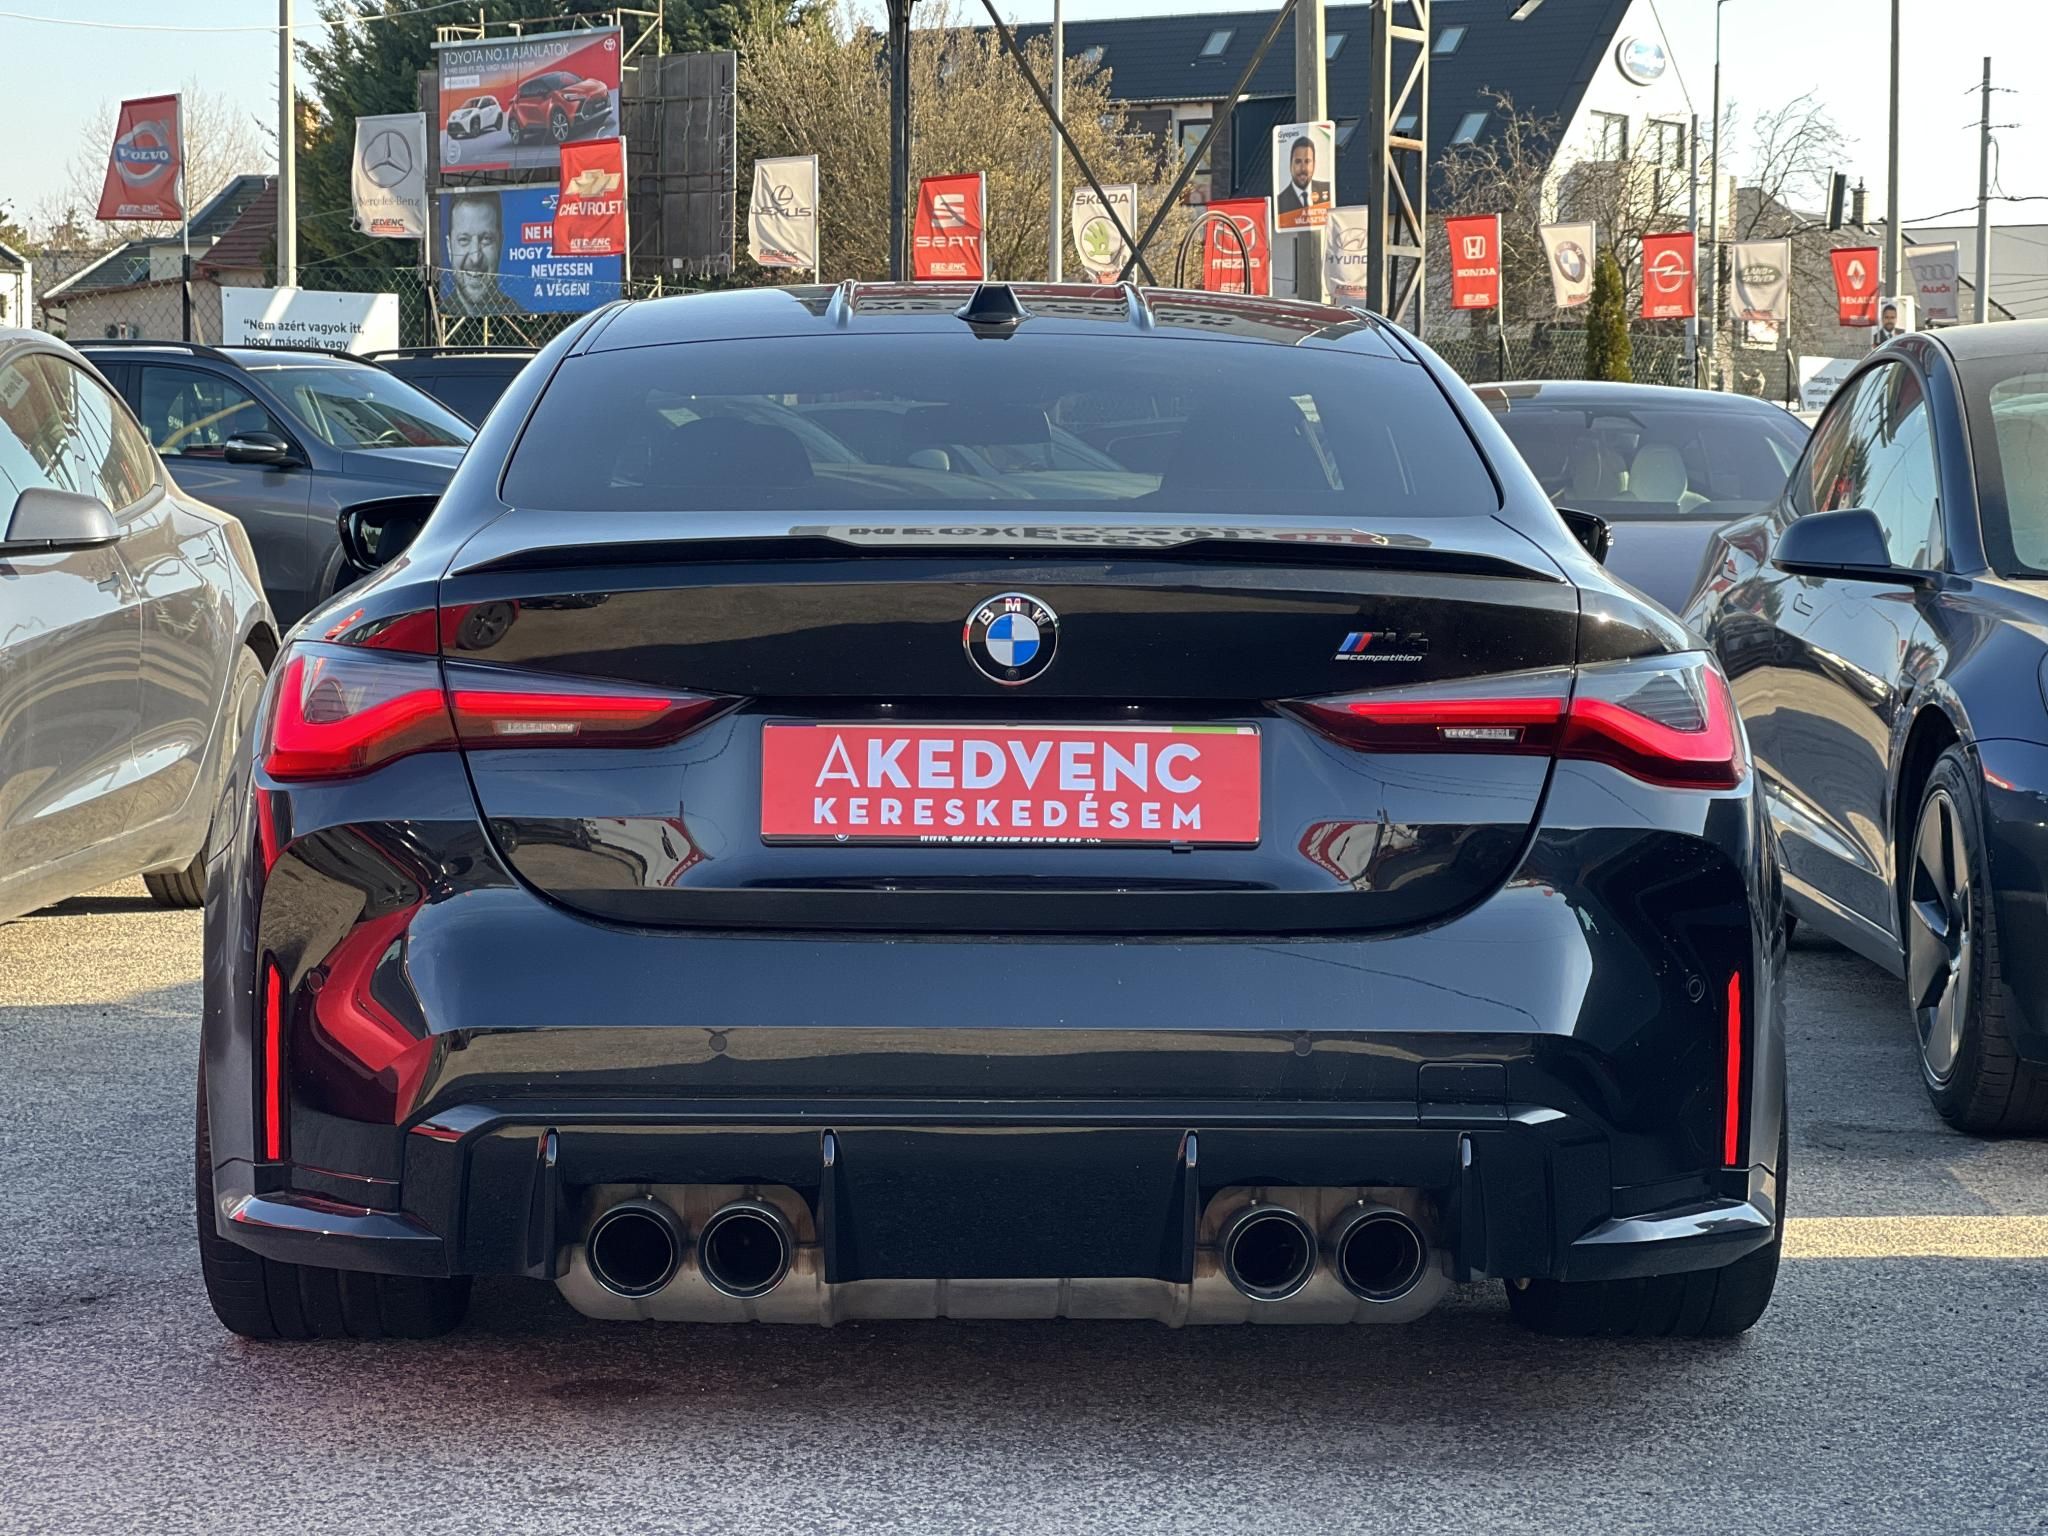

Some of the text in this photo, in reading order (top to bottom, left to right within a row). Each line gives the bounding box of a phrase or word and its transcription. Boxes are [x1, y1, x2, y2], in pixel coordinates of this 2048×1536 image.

[444, 42, 570, 65] TOYOTA NO.1 AJÁNLATOK
[120, 148, 169, 160] VOLVO
[1075, 192, 1129, 205] ŠKDA
[559, 200, 622, 217] CHEVROLET
[751, 206, 812, 217] LEXUS
[525, 226, 541, 240] NE
[915, 235, 978, 247] SEAT
[509, 247, 544, 261] HOGY
[531, 262, 594, 278] NEVESSEN
[1457, 267, 1497, 277] HONDA
[534, 281, 590, 297] A VÉGEN!
[278, 320, 306, 332] azért
[309, 322, 347, 335] vagyok
[244, 335, 349, 351] hogy második vagy
[977, 597, 1050, 626] BMW
[1349, 654, 1423, 662] competition
[812, 793, 1203, 830] KERESKEDÉSEM
